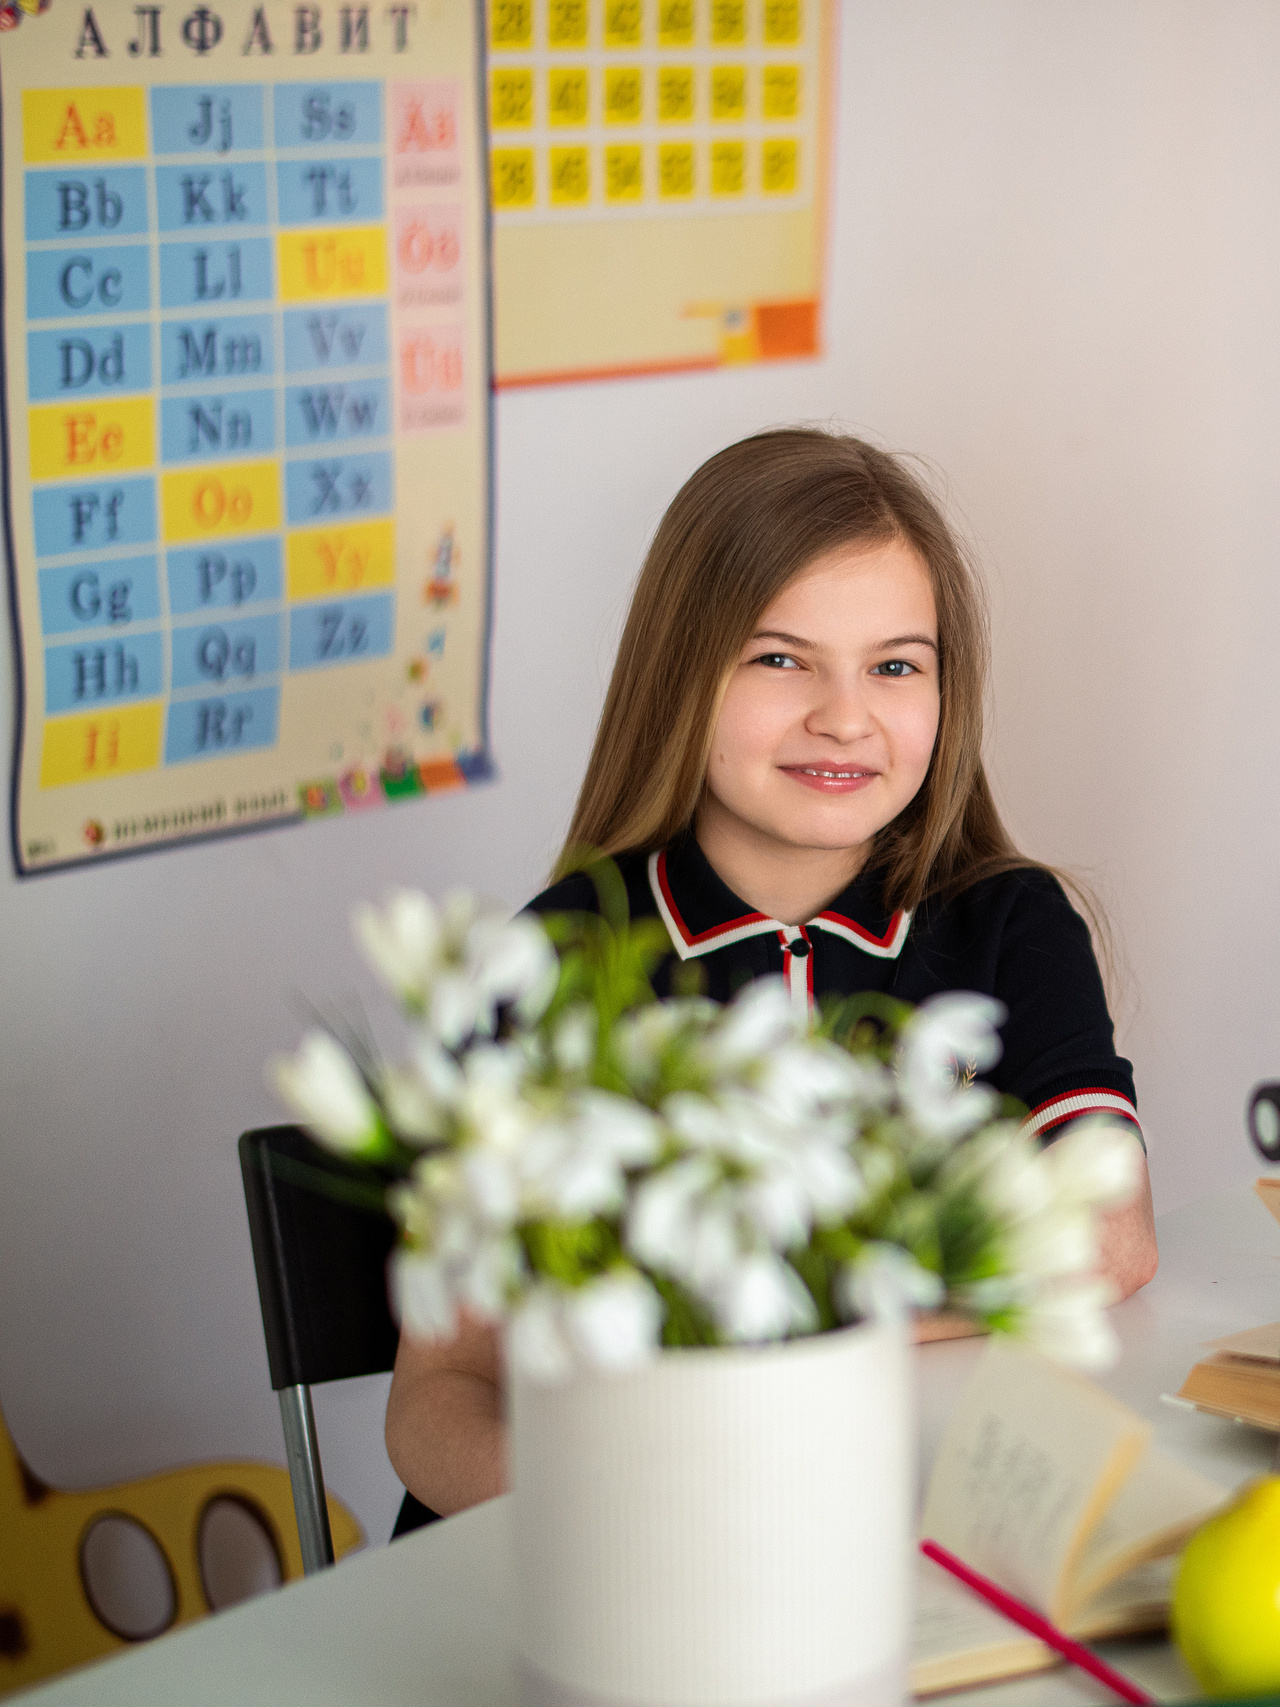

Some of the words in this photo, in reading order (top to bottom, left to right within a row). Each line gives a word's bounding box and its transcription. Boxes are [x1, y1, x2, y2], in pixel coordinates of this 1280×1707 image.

[74, 3, 416, 59] АЛФАВИТ
[54, 102, 117, 150] Aa
[187, 94, 234, 156] Jj
[303, 89, 356, 141] Ss
[56, 178, 124, 232] Bb
[180, 170, 248, 225] Kk
[306, 163, 357, 218] Tt
[59, 255, 124, 310] Cc
[193, 244, 242, 301] Ll
[303, 236, 366, 293] Uu
[59, 331, 126, 390] Dd
[178, 325, 263, 380] Mm
[307, 312, 365, 363] Vv
[64, 412, 125, 466] Ee
[187, 400, 253, 454] Nn
[300, 388, 379, 439] Ww
[191, 474, 254, 530] Oo
[310, 462, 372, 515] Xx
[68, 489, 125, 545] Ff
[196, 548, 258, 611] Pp
[315, 533, 371, 592] Yy
[68, 569, 134, 627] Gg
[196, 624, 258, 686] Qq
[315, 607, 369, 661] Zz
[71, 642, 140, 703] Hh
[195, 700, 253, 751] Rr
